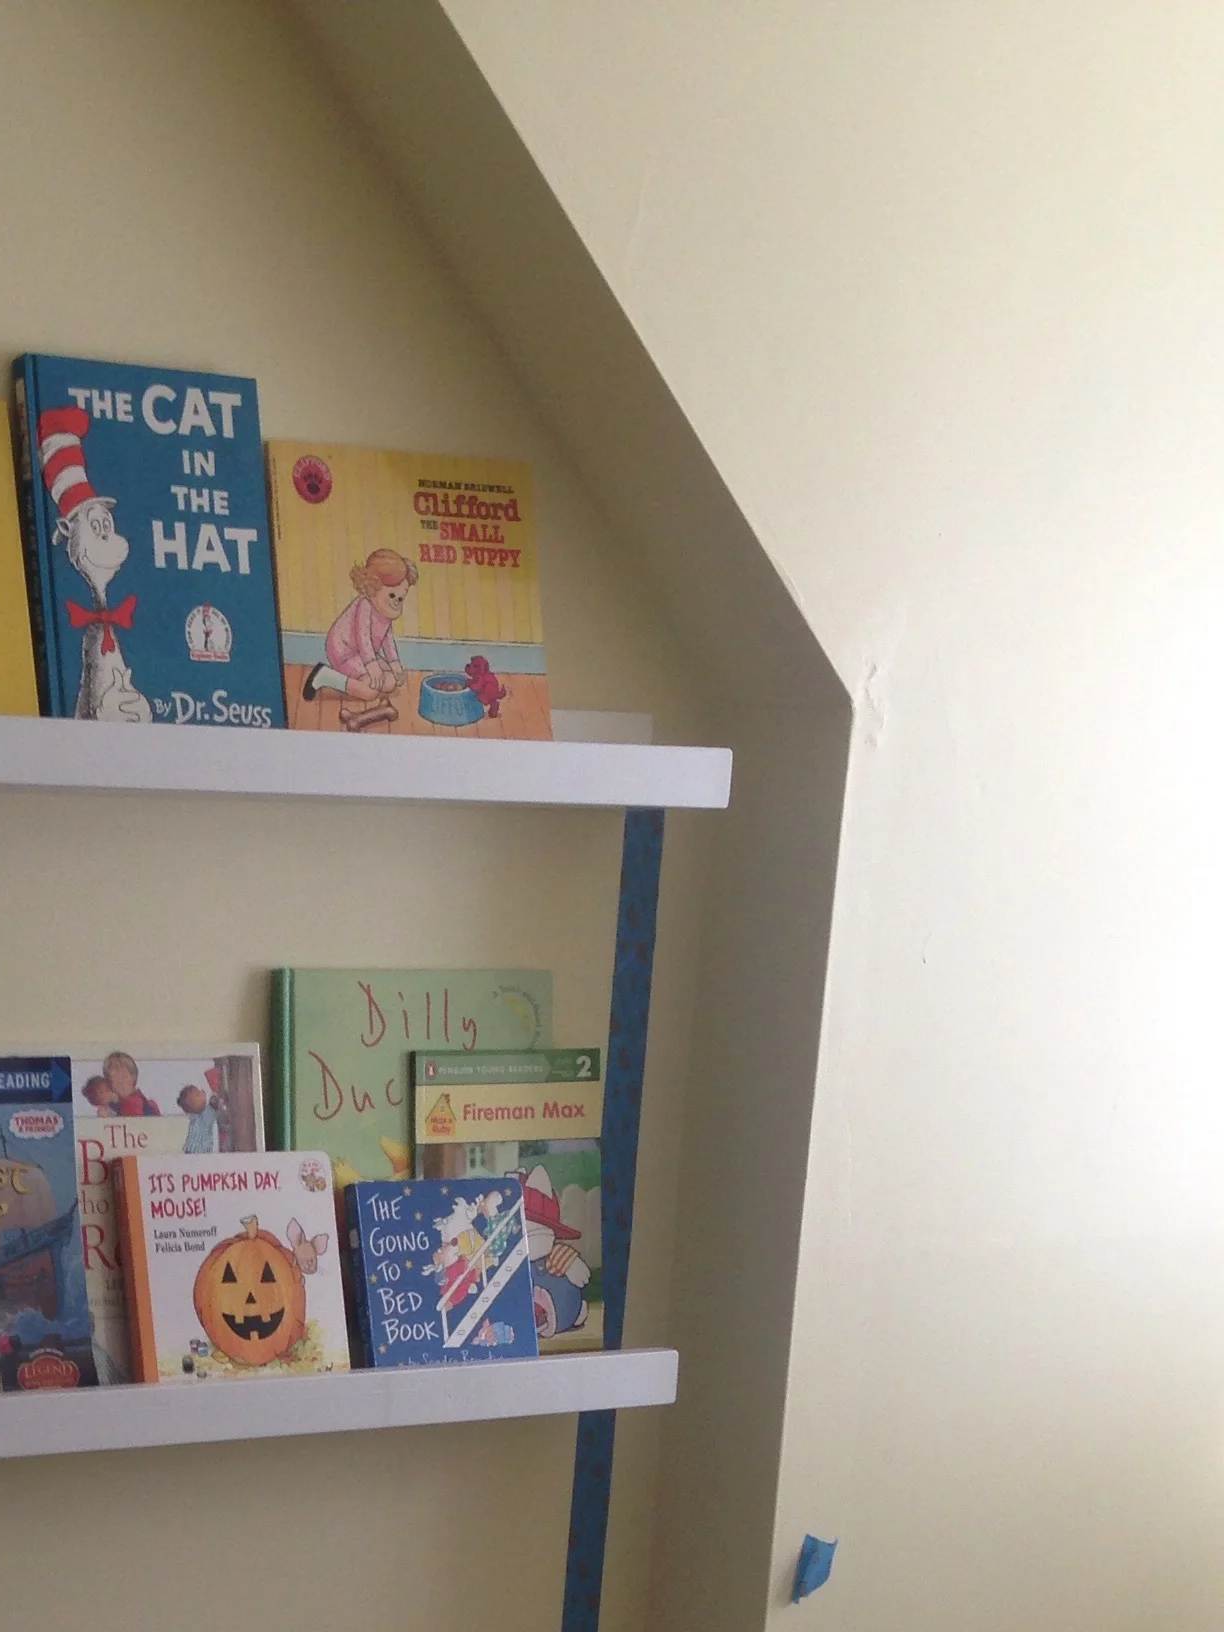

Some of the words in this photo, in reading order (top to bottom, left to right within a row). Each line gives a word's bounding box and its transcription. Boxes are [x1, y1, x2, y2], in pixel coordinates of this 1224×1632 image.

[68, 386, 134, 423] THE
[142, 384, 242, 439] CAT
[182, 448, 216, 477] IN
[171, 484, 230, 516] THE
[413, 490, 522, 523] Clifford
[440, 521, 506, 545] SMALL
[152, 520, 259, 576] HAT
[418, 543, 458, 565] RED
[462, 546, 522, 568] PUPPY
[154, 696, 173, 716] By
[171, 690, 207, 725] Dr.
[212, 689, 272, 728] Seuss
[357, 979, 478, 1052] Dilly
[575, 1054, 593, 1079] 2
[308, 1049, 405, 1122] Duc
[14, 1115, 59, 1126] THOMAS
[463, 1101, 536, 1122] Fireman
[542, 1100, 586, 1120] Max
[103, 1123, 149, 1149] The
[148, 1172, 176, 1195] IT'S
[181, 1171, 248, 1193] PUMPKIN
[150, 1196, 209, 1219] MOUSE!
[366, 1191, 405, 1223] THE
[153, 1228, 178, 1240] Laura
[179, 1226, 218, 1238] Numeroff
[368, 1230, 431, 1257] GOING
[155, 1242, 182, 1254] Felicia
[183, 1241, 206, 1253] Bond
[376, 1259, 401, 1283] TO
[379, 1286, 424, 1316] BED
[380, 1318, 441, 1345] BOOK
